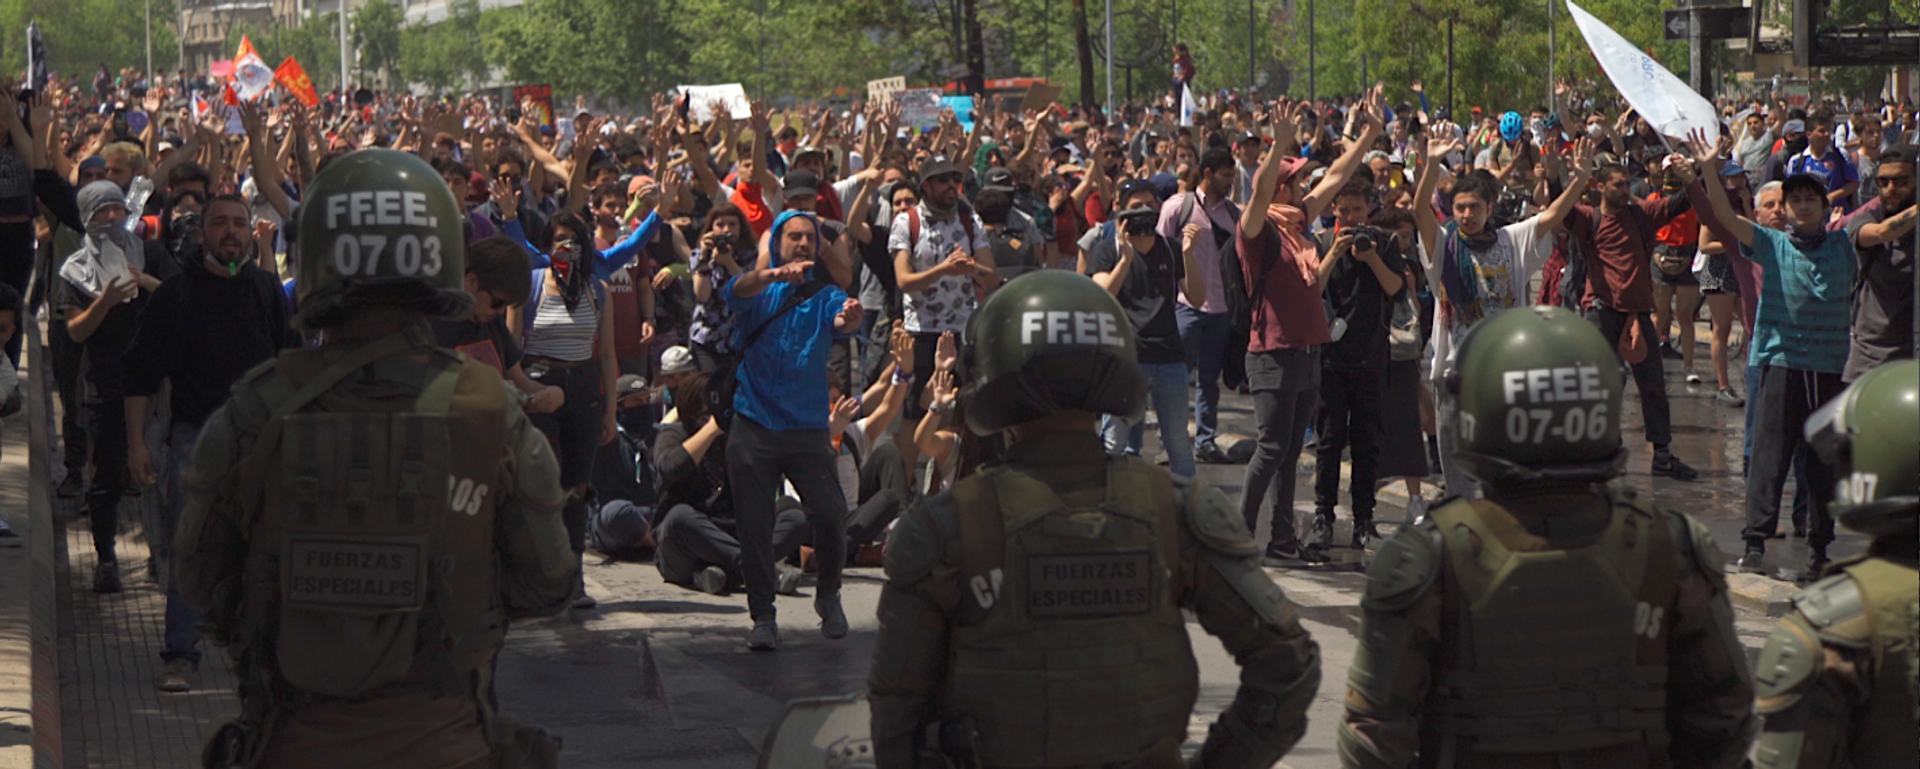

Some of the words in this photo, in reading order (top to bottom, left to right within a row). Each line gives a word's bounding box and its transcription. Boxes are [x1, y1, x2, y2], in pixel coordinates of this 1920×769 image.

[327, 190, 438, 229] FF.EE.
[335, 234, 387, 276] 07
[395, 234, 443, 277] 03
[1505, 403, 1608, 444] 07-06
[305, 550, 403, 570] FUERZAS
[1042, 562, 1137, 580] FUERZAS
[293, 576, 413, 597] ESPECIALES
[1031, 587, 1147, 607] ESPECIALES
